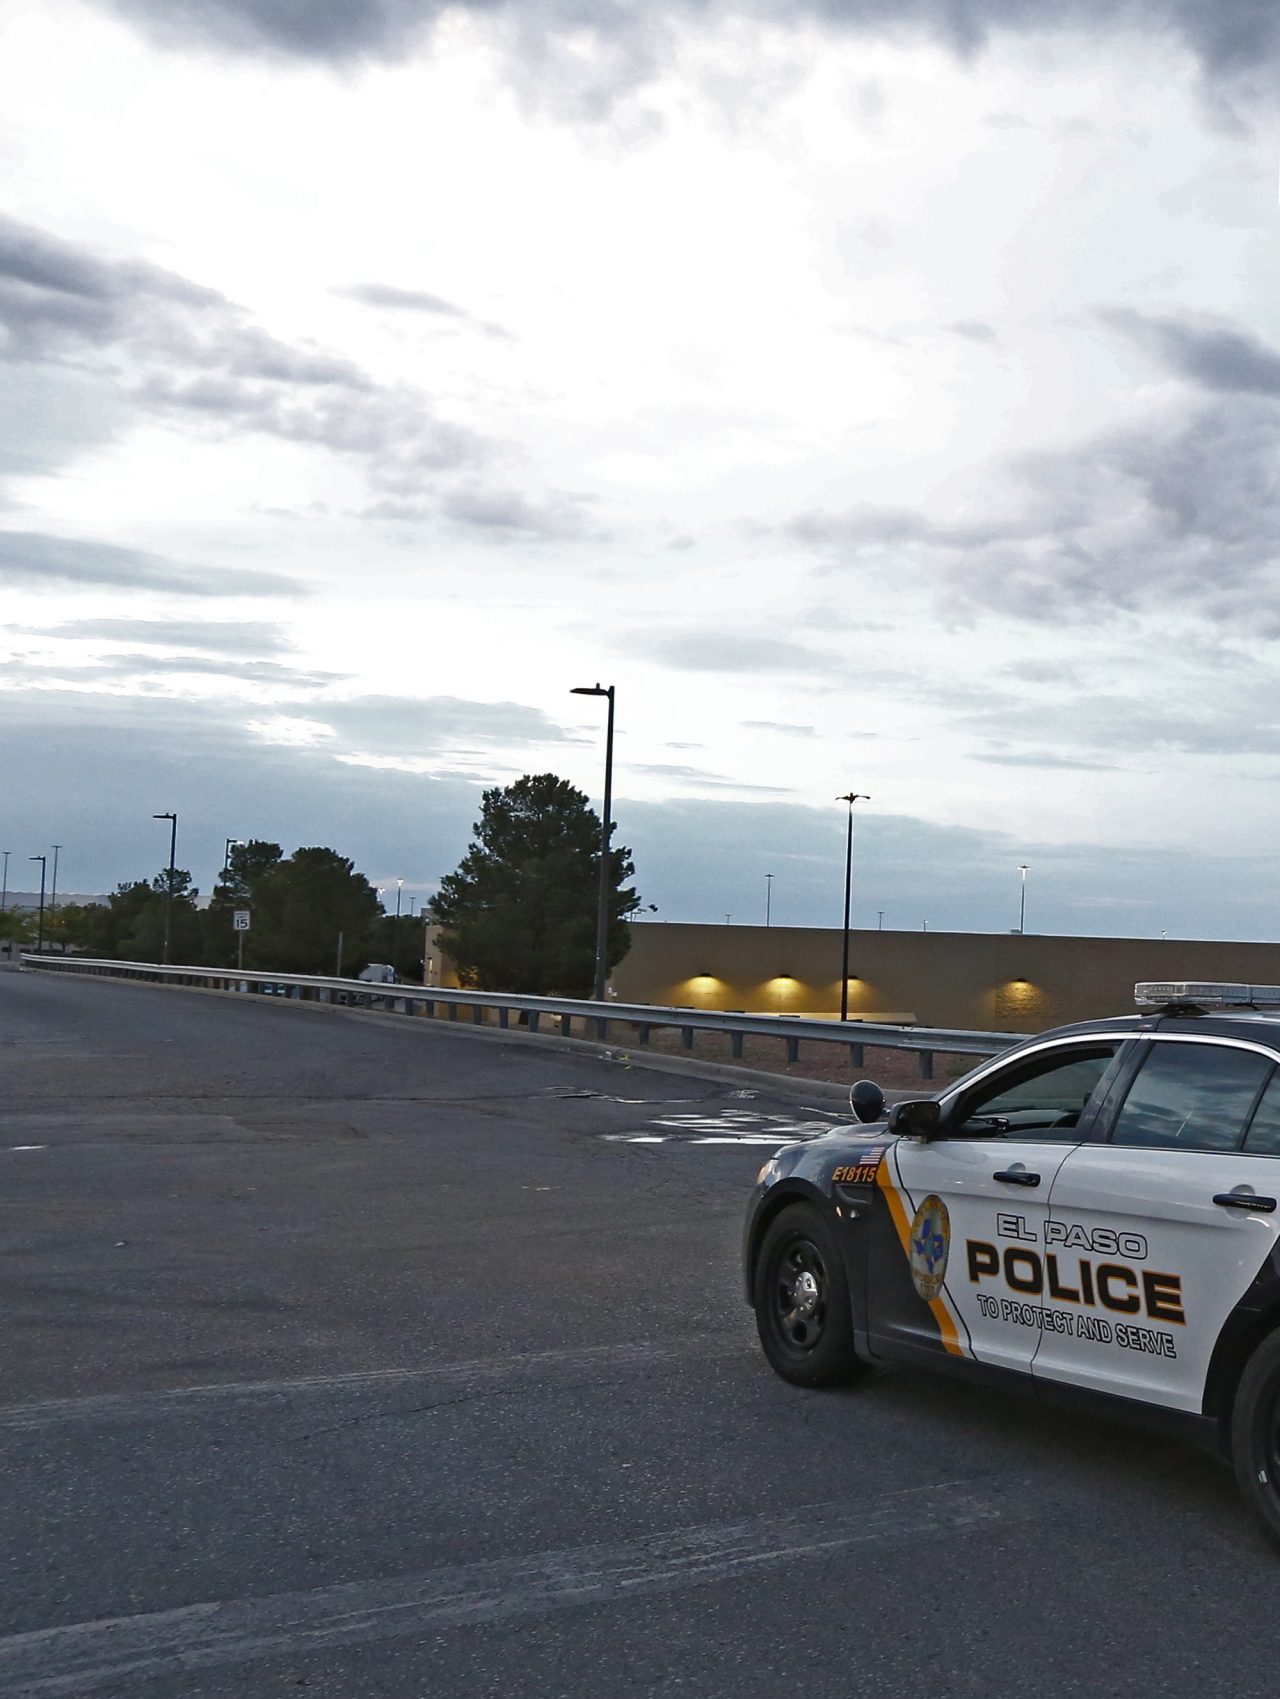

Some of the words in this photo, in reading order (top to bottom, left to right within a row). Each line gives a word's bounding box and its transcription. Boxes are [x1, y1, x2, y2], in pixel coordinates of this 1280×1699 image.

[236, 918, 248, 929] 15
[831, 1166, 877, 1183] E18115
[996, 1213, 1038, 1242] EL
[1044, 1221, 1148, 1260] PASO
[966, 1239, 1187, 1326] POLICE
[976, 1294, 999, 1319] TO
[1001, 1299, 1074, 1335] PROTECT
[1077, 1315, 1113, 1343] AND
[1115, 1323, 1177, 1358] SERVE
